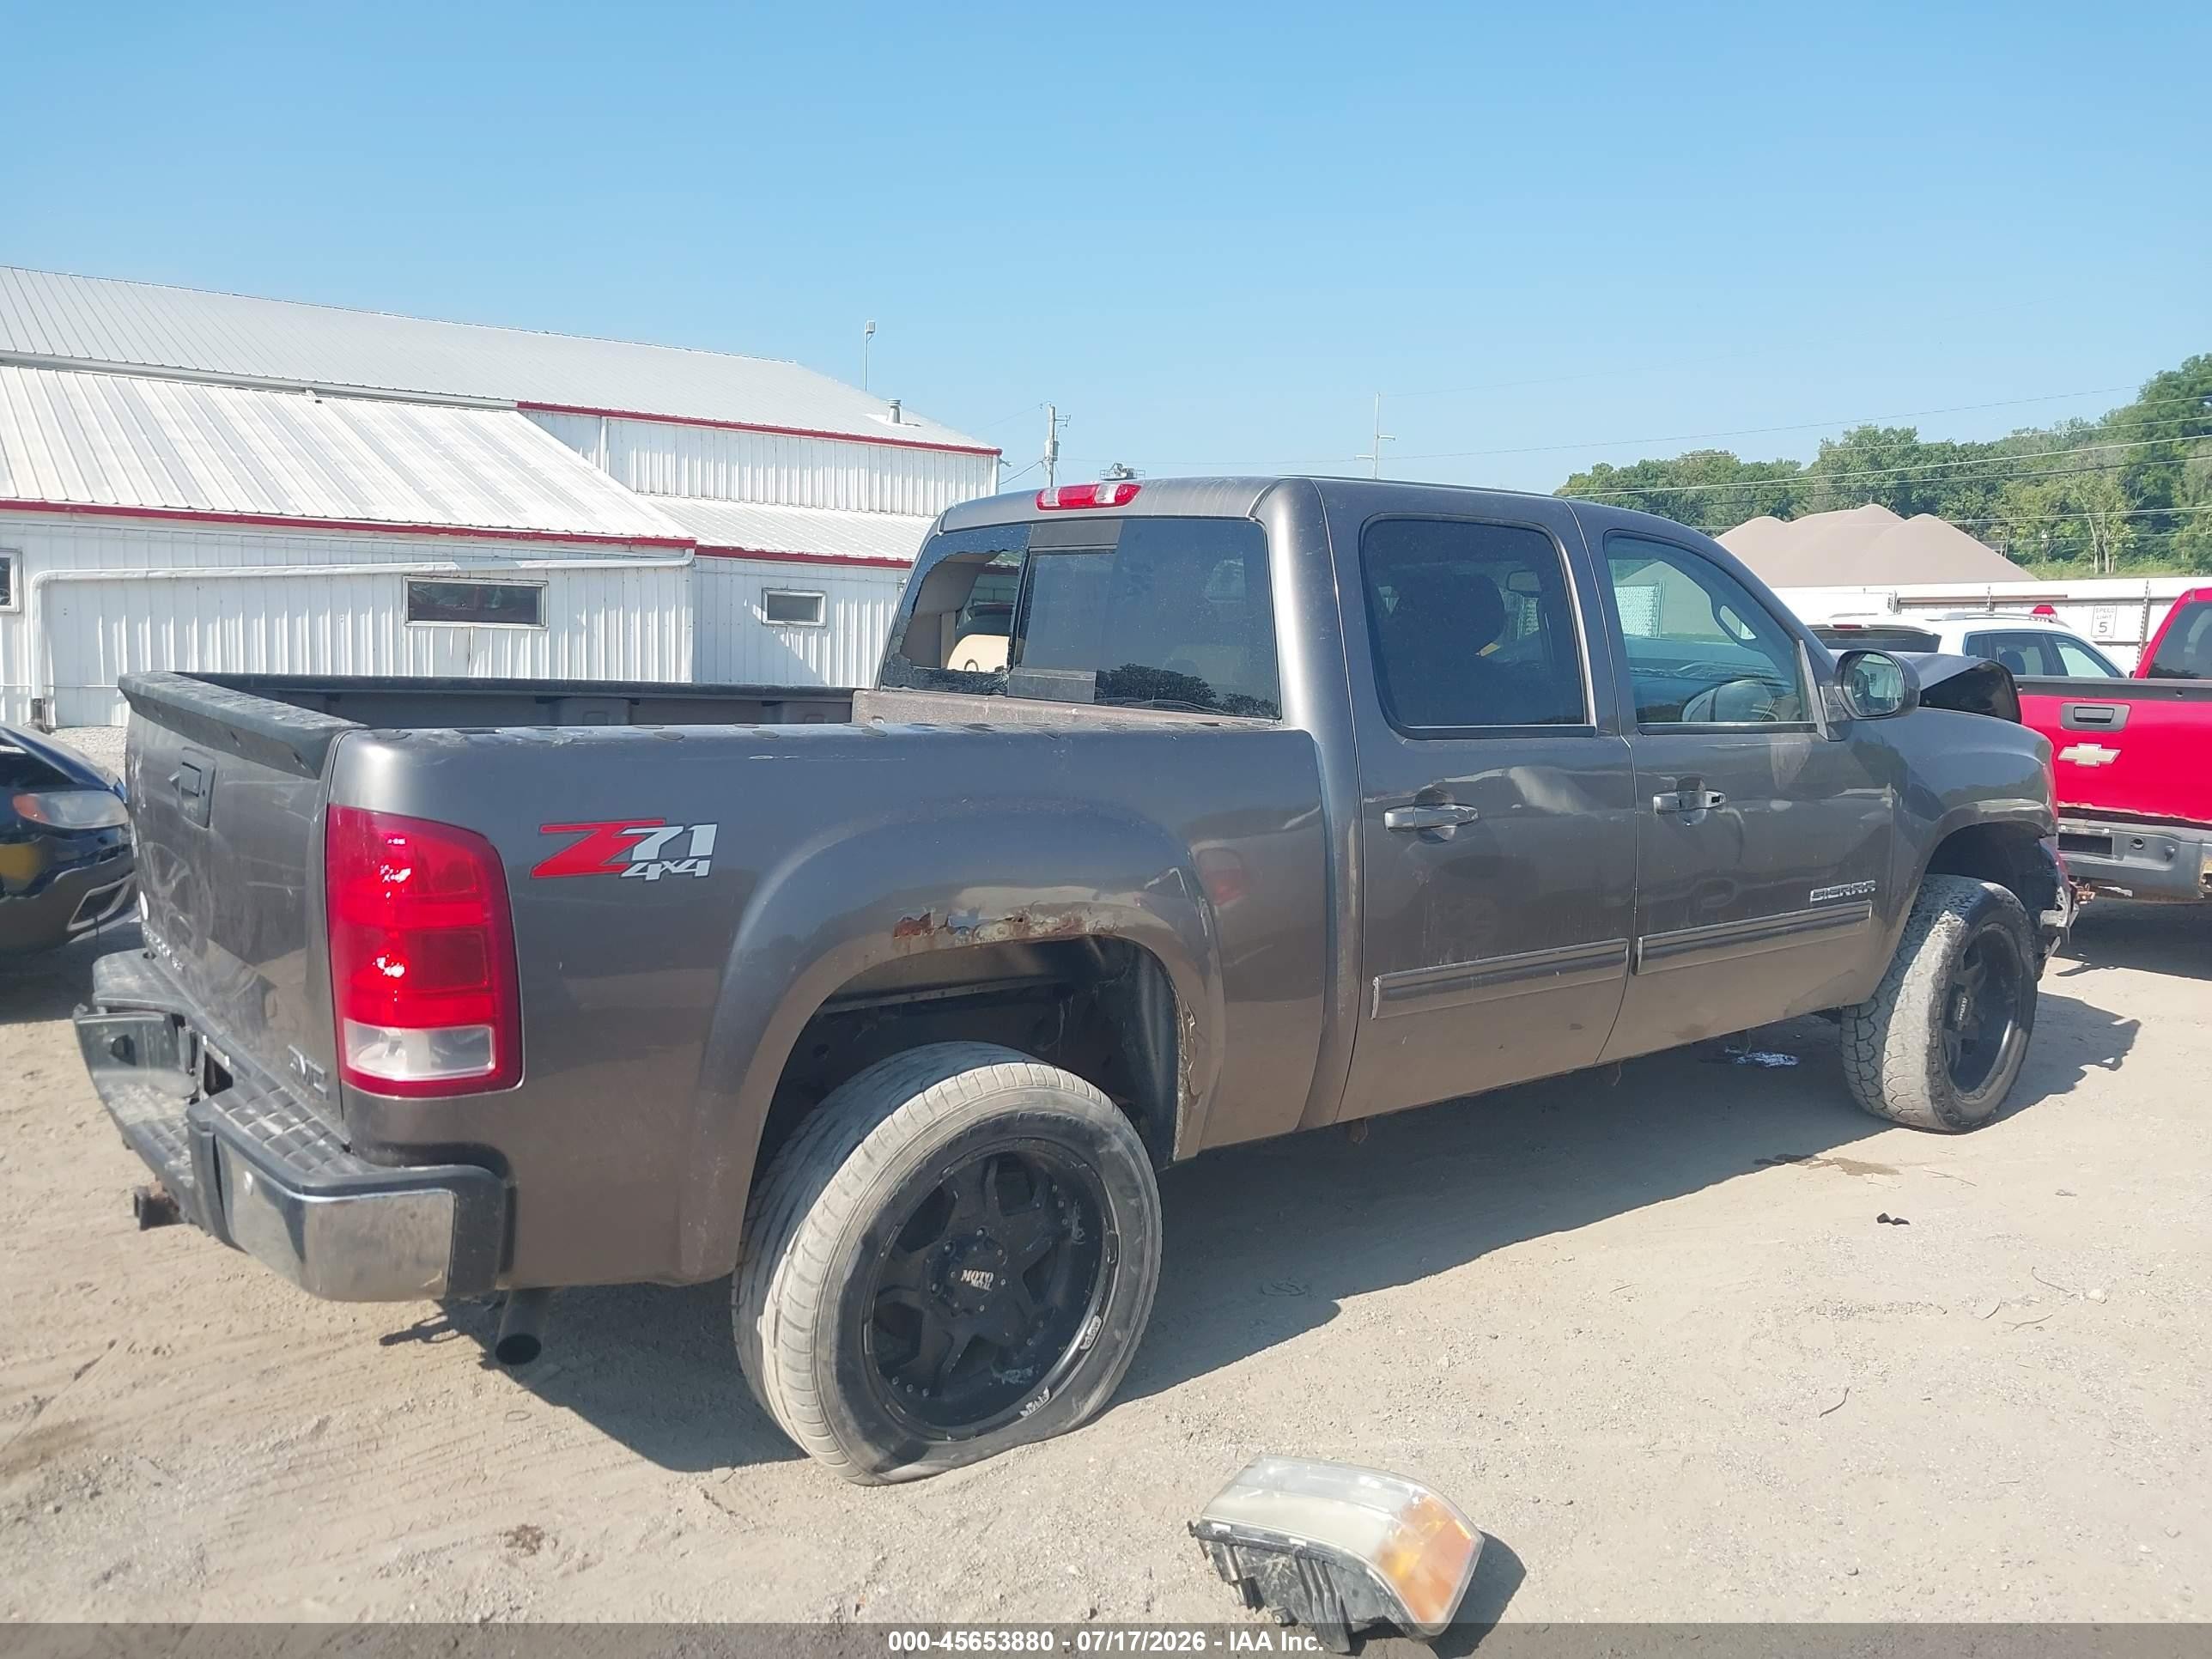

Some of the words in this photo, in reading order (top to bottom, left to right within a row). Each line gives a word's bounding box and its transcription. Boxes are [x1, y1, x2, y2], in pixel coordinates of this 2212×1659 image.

[2099, 622, 2108, 633] 5
[530, 817, 719, 879] Z71
[1809, 879, 1876, 902] SIERRA
[960, 1269, 994, 1284] MOTO
